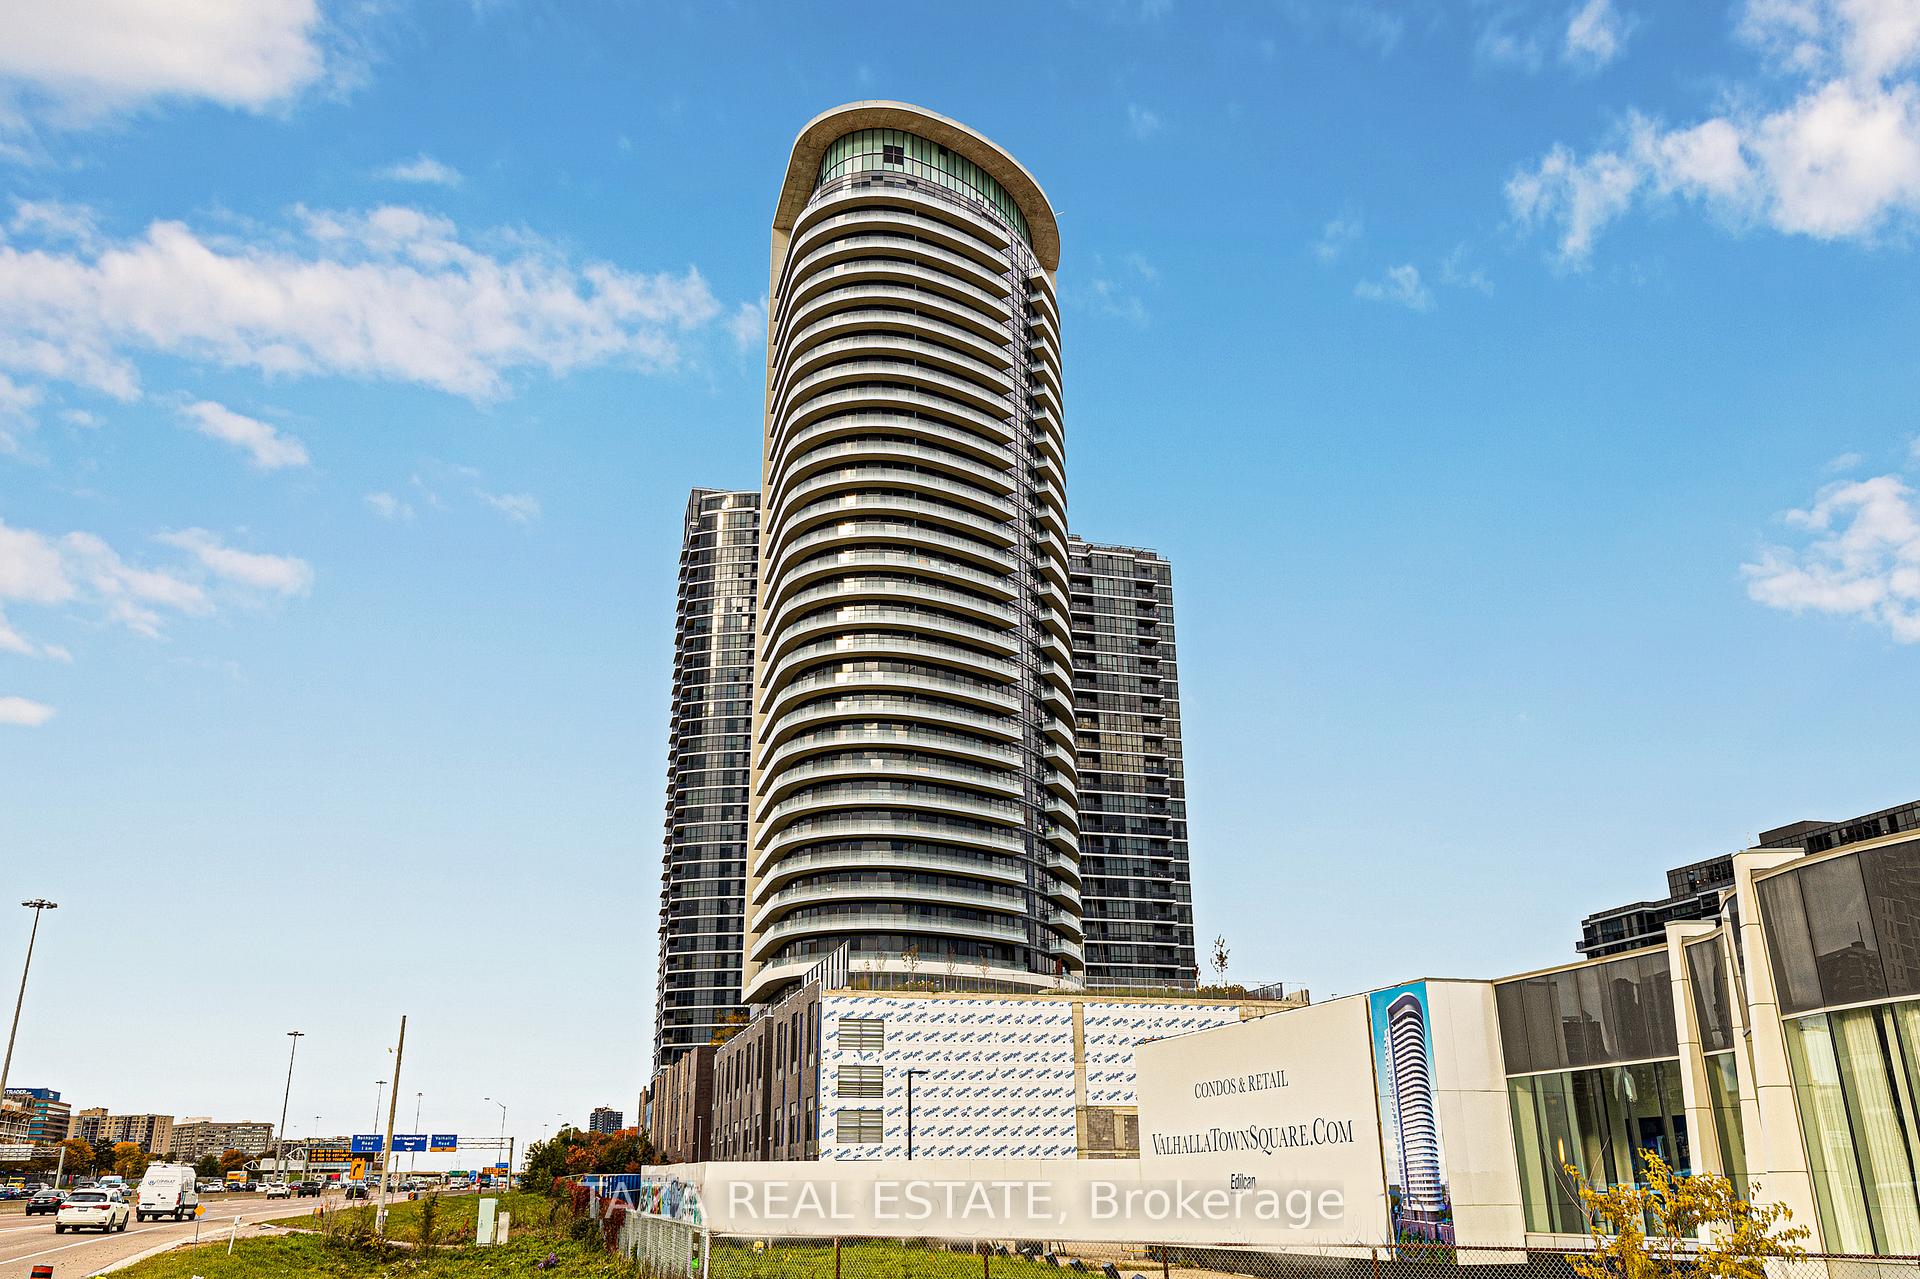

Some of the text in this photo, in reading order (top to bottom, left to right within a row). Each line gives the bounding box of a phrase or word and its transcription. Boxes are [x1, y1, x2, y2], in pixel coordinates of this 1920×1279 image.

[1194, 1070, 1289, 1099] CONDOS & RETAIL
[1230, 1173, 1256, 1190] Edilcan
